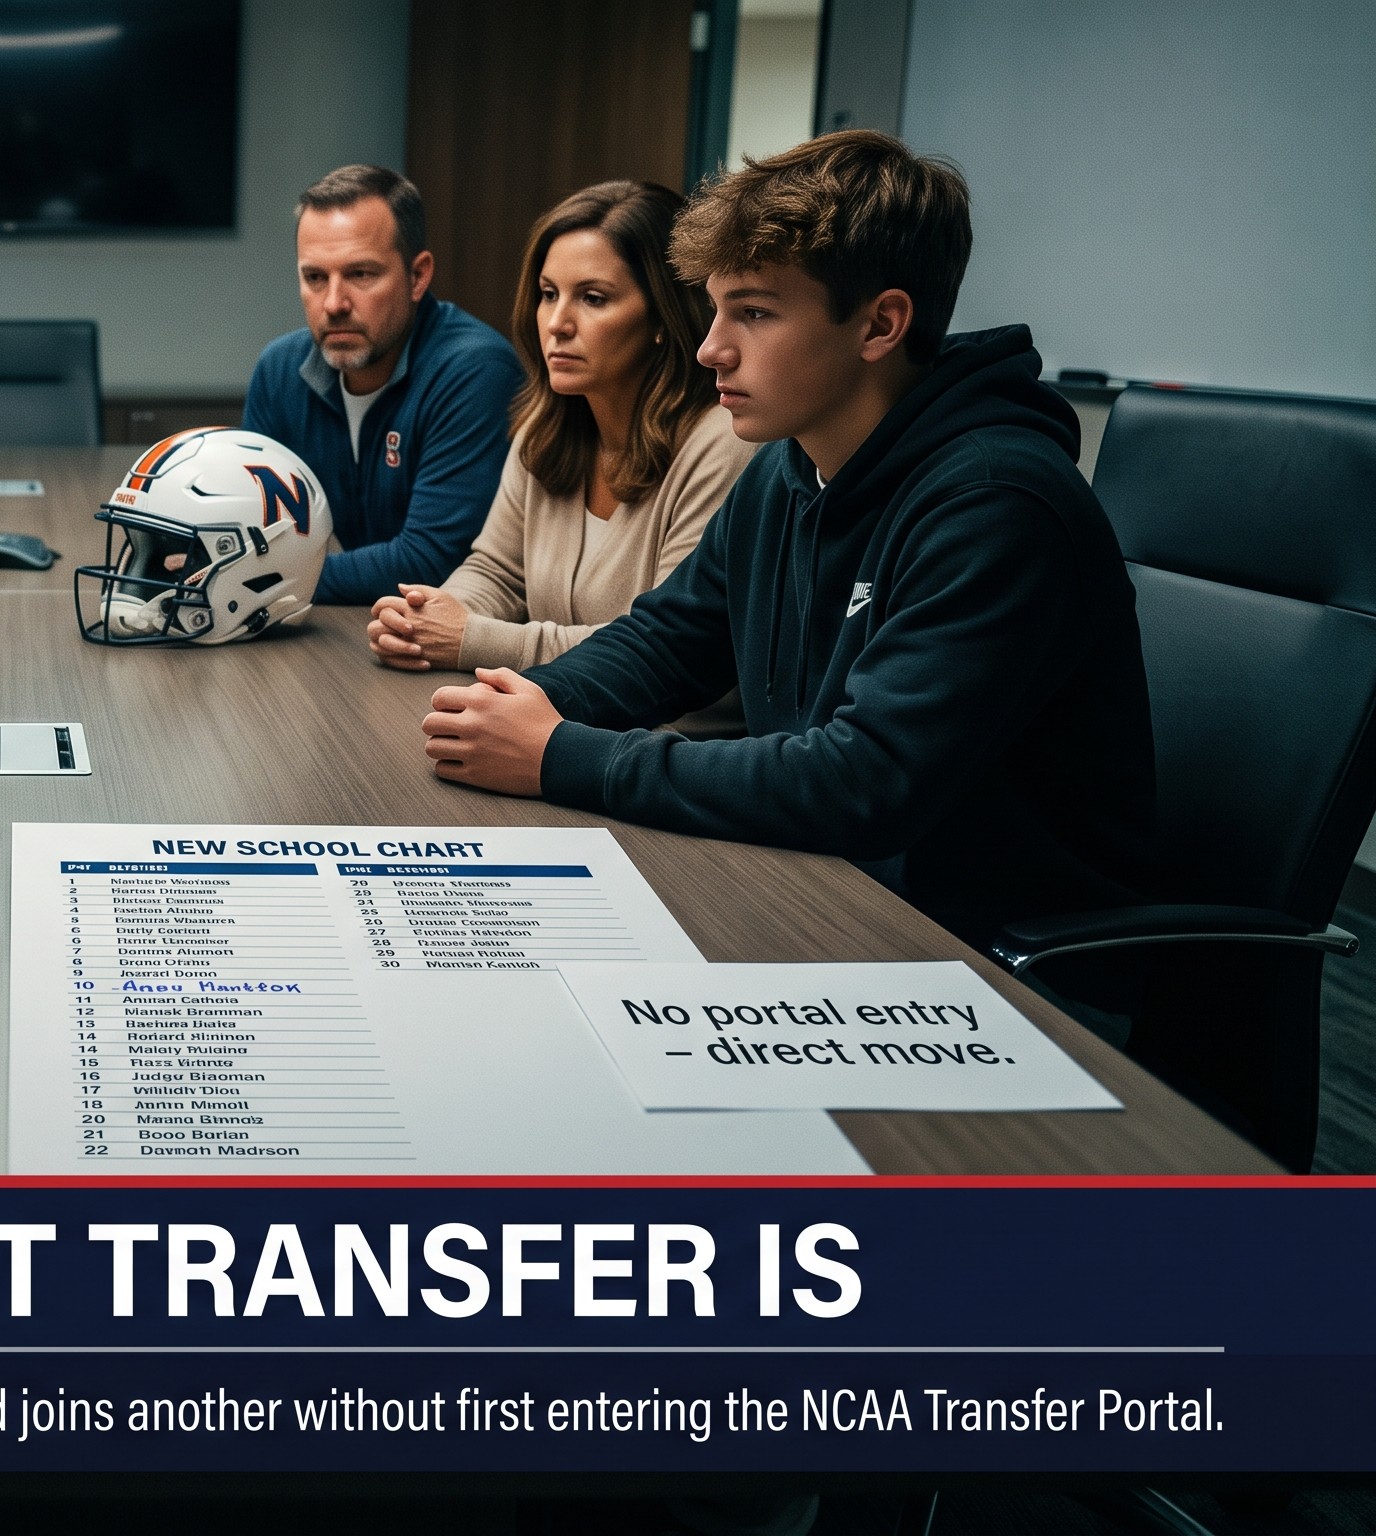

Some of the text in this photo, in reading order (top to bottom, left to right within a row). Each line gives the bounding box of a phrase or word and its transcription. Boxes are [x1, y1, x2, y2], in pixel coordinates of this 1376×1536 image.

[243, 465, 310, 537] N
[152, 840, 484, 857] NEW SCHOOL CHART
[73, 980, 96, 989] 10
[76, 1007, 96, 1015] 12
[622, 998, 979, 1032] No portal entry
[76, 1019, 97, 1027] 13
[77, 1032, 98, 1040] 14
[78, 1045, 99, 1053] 14
[707, 1037, 856, 1065] direct
[867, 1043, 1015, 1065] move.
[79, 1058, 100, 1066] 15
[79, 1071, 102, 1080] 16
[81, 1085, 102, 1094] 17
[81, 1099, 104, 1109] 18
[82, 1114, 107, 1123] 20
[83, 1129, 105, 1138] 21
[84, 1144, 110, 1155] 22
